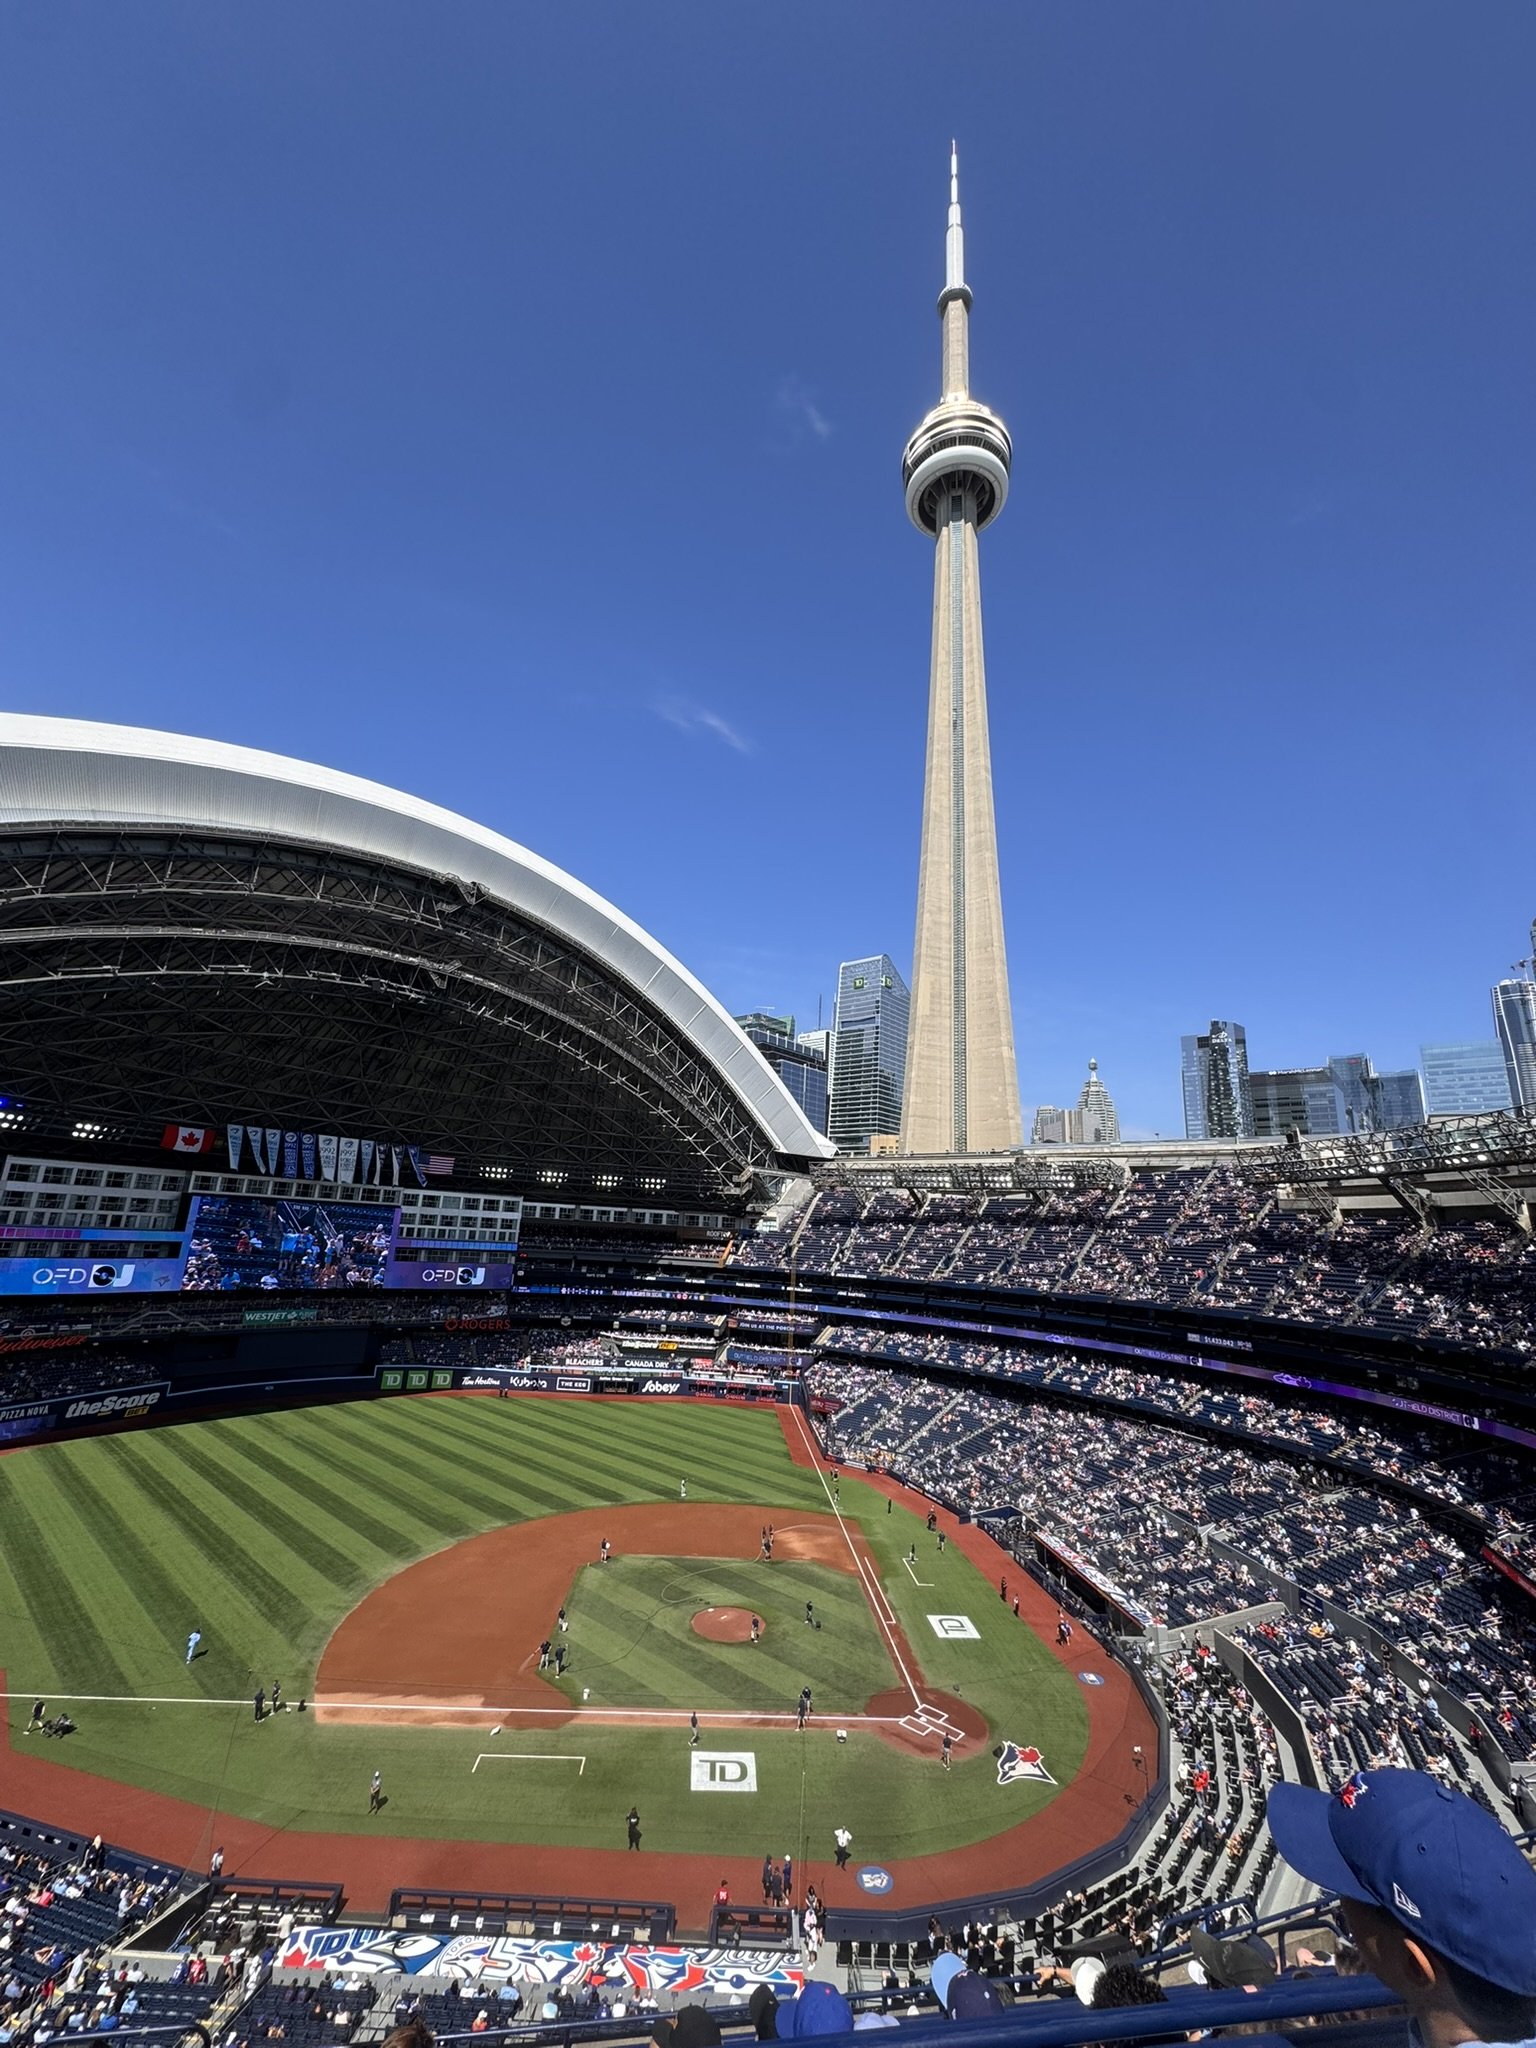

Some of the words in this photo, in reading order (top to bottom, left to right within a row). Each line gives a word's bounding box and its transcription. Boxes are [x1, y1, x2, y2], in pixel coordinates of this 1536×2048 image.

[245, 1312, 287, 1322] WESTJET
[460, 1320, 511, 1330] ROGERS
[565, 1358, 604, 1366] BLEACHERS
[385, 1374, 400, 1386] TD
[410, 1374, 425, 1386] TD
[434, 1373, 450, 1385] TD
[462, 1376, 474, 1385] Tim
[474, 1376, 501, 1385] Hortons
[642, 1380, 680, 1394] Sobeys
[65, 1392, 160, 1418] theScore
[0, 1409, 25, 1421] PIZZA
[26, 1405, 49, 1416] NOVA
[699, 1759, 748, 1783] TD
